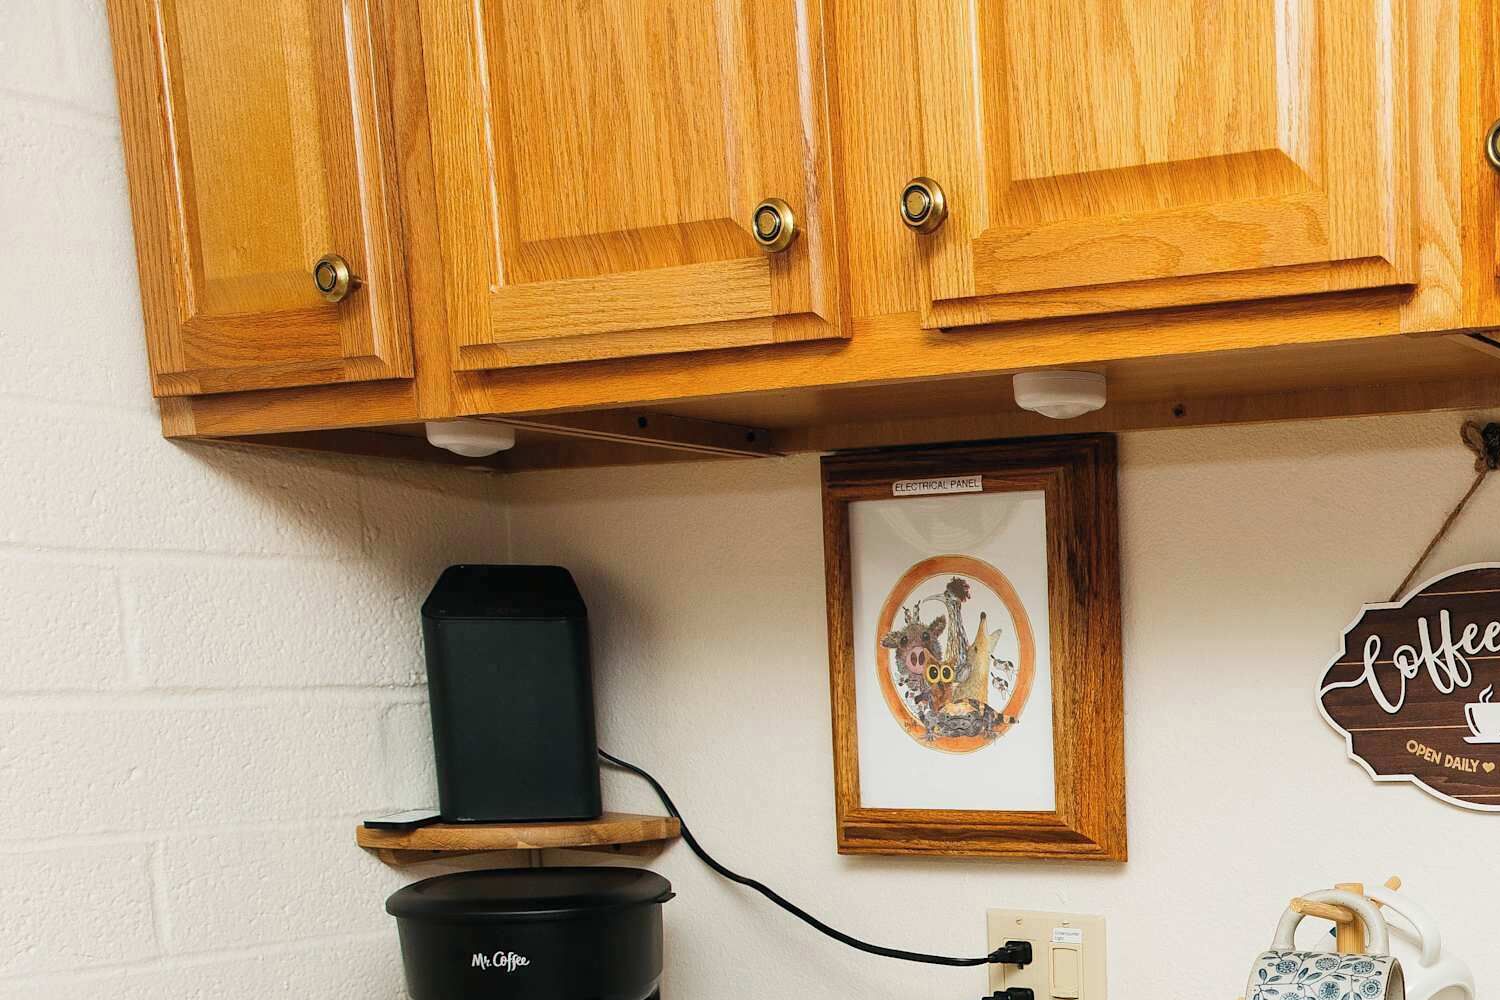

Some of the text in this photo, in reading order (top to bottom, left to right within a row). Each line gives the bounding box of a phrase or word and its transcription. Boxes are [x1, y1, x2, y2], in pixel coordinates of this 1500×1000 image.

[895, 479, 979, 491] ELECTRICAL PANEL
[1406, 739, 1442, 764] OPEN
[1444, 754, 1480, 773] DAILY
[471, 950, 530, 972] Mr. Coffee
